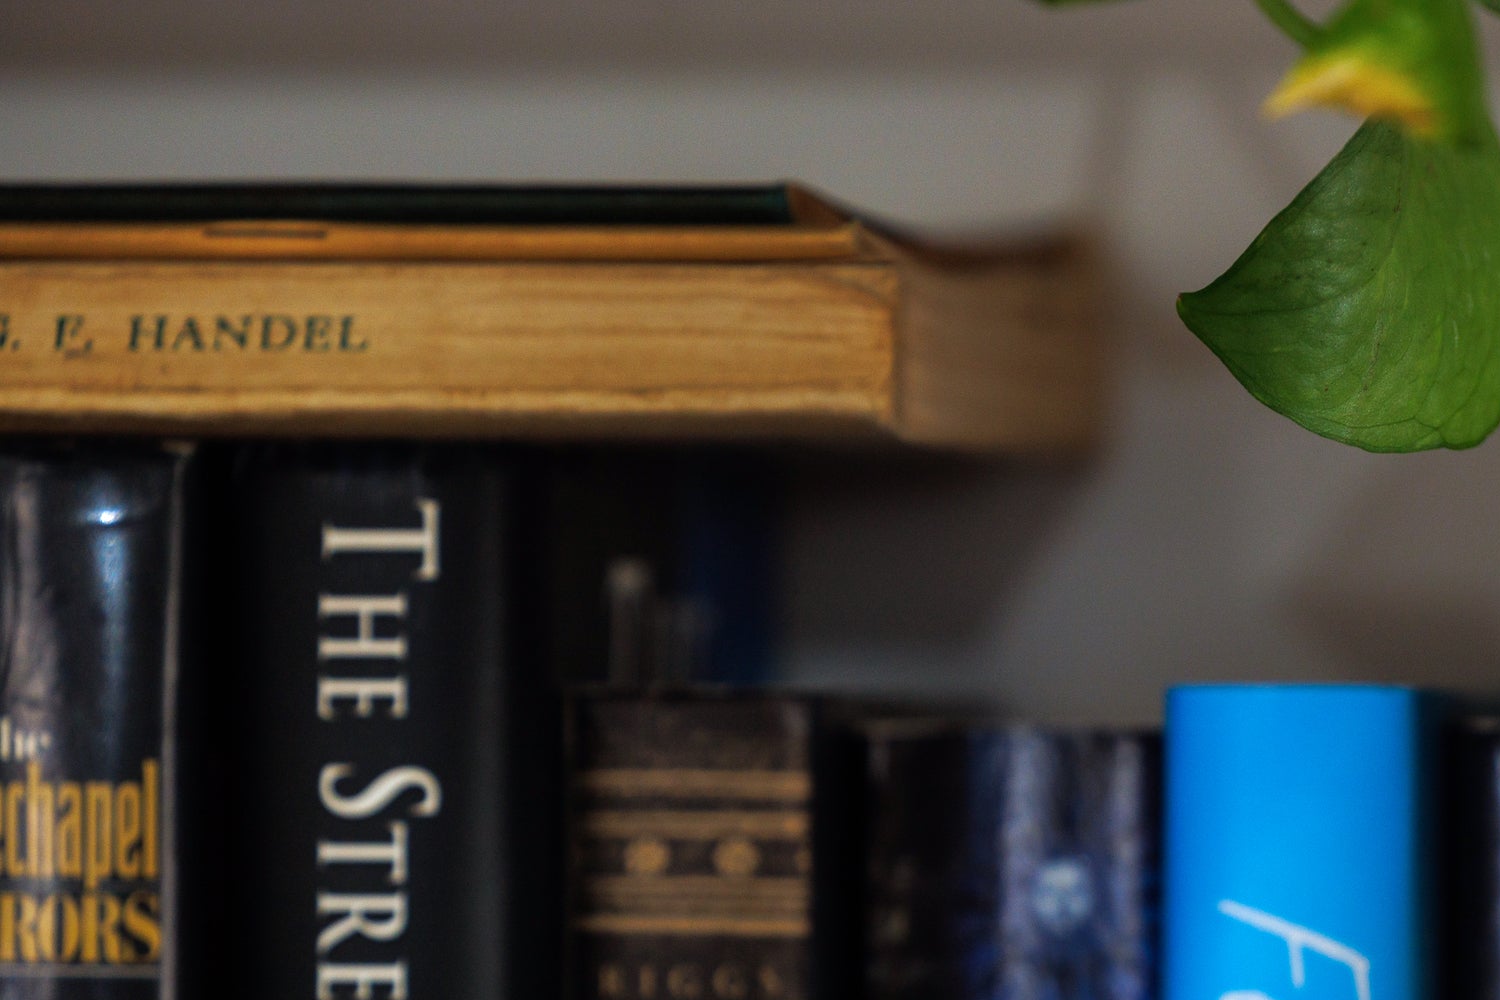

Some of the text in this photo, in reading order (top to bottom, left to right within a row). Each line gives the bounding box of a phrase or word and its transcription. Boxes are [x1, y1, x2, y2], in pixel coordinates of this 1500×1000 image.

[128, 313, 370, 353] HANDEL
[316, 498, 440, 721] THE
[0, 757, 159, 890] chapel
